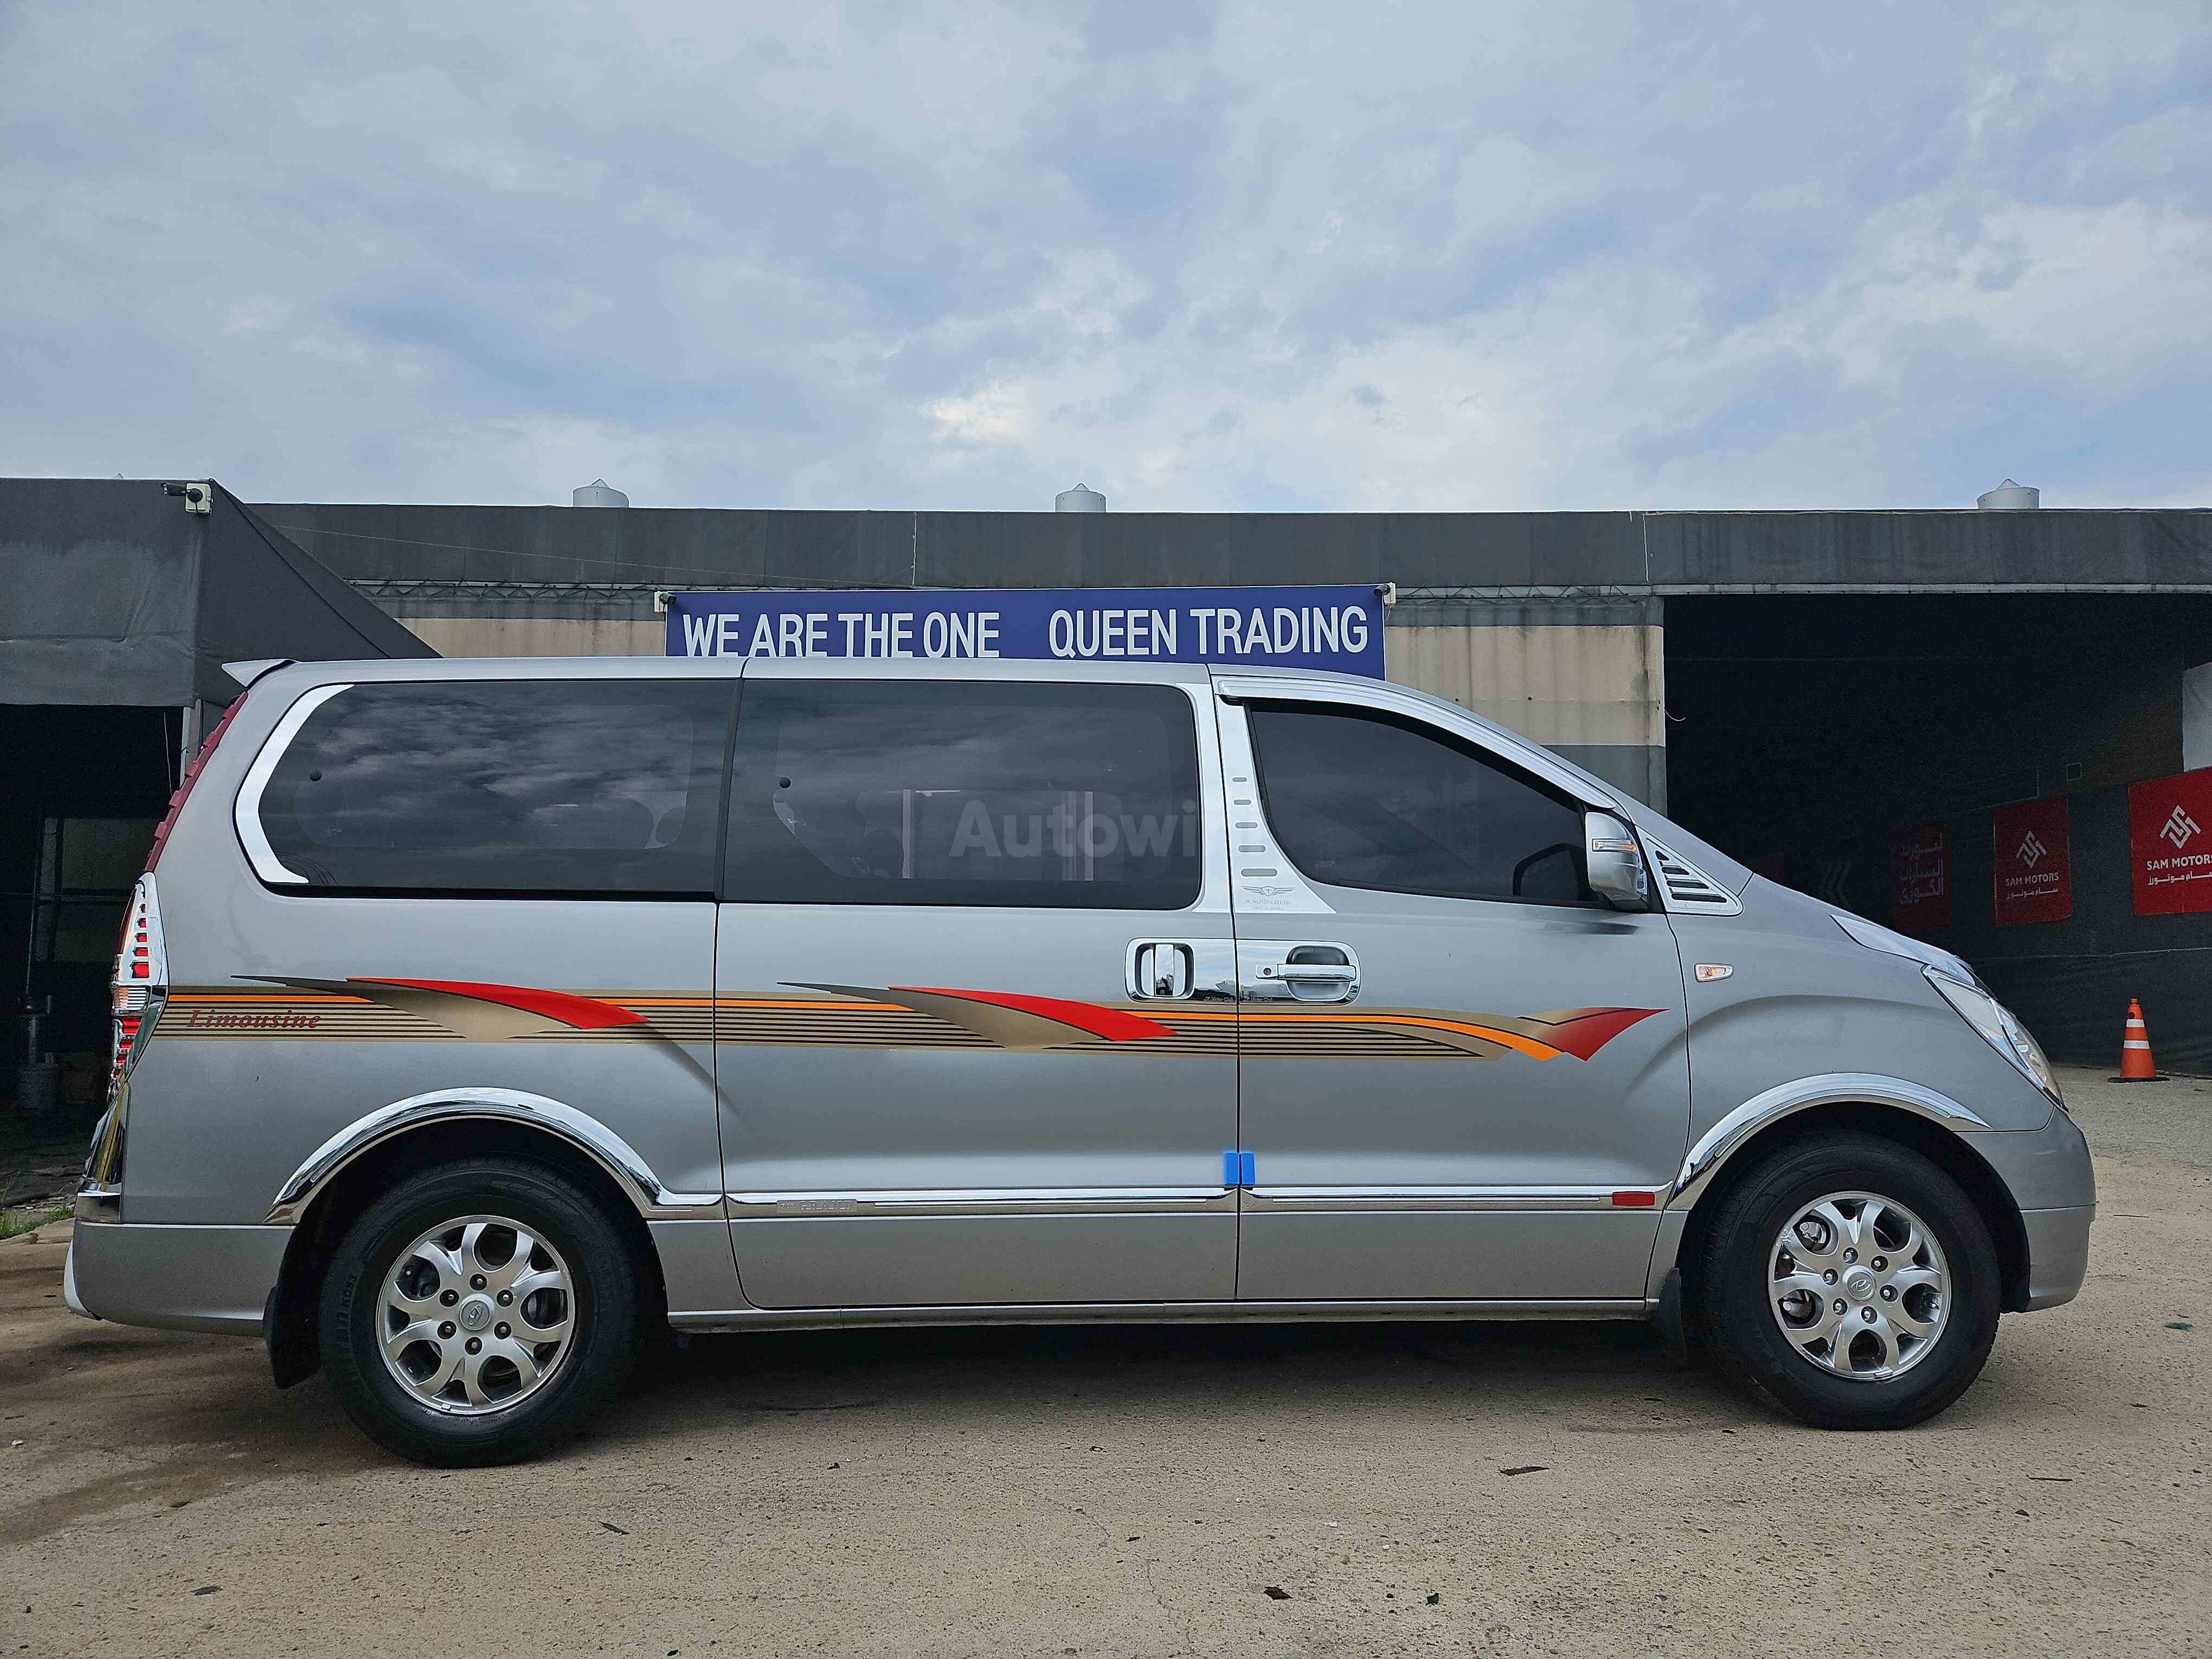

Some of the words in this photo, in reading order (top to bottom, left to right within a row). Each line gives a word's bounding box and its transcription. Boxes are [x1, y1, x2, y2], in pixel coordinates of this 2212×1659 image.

[683, 613, 739, 658] WE
[748, 613, 828, 658] ARE
[838, 613, 914, 658] THE
[923, 612, 1000, 658] ONE
[1049, 608, 1176, 658] QUEEN
[1190, 606, 1368, 654] TRADING
[2147, 859, 2169, 871] SAM
[2172, 854, 2212, 868] MOTOR
[2006, 877, 2022, 886] SAM
[2024, 872, 2059, 884] MOTORS
[187, 1009, 321, 1028] Limousine
